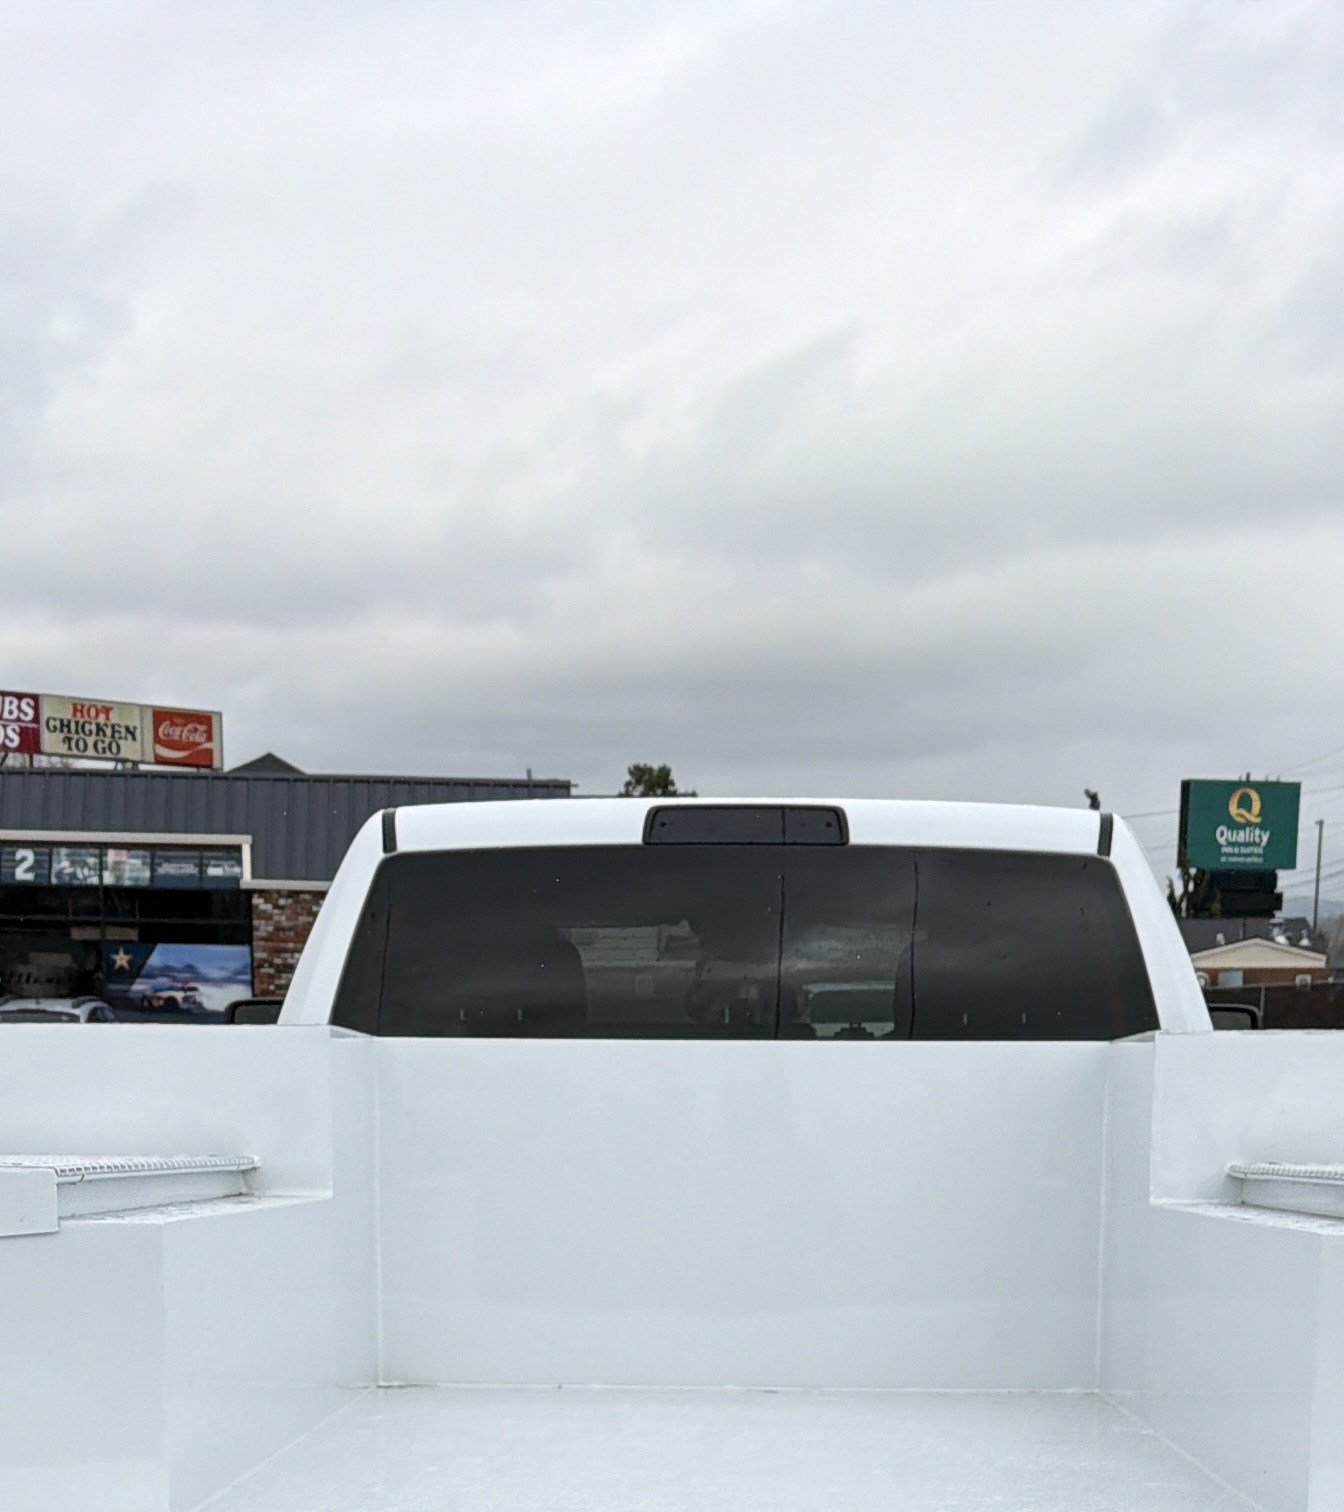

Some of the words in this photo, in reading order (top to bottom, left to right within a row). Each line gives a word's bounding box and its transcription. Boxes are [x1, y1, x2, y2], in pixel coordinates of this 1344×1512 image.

[70, 701, 115, 722] HOT
[45, 716, 138, 743] CHICKEN
[61, 735, 89, 753] TO
[92, 738, 122, 756] GO
[1215, 824, 1271, 848] Quality
[14, 848, 36, 882] 2
